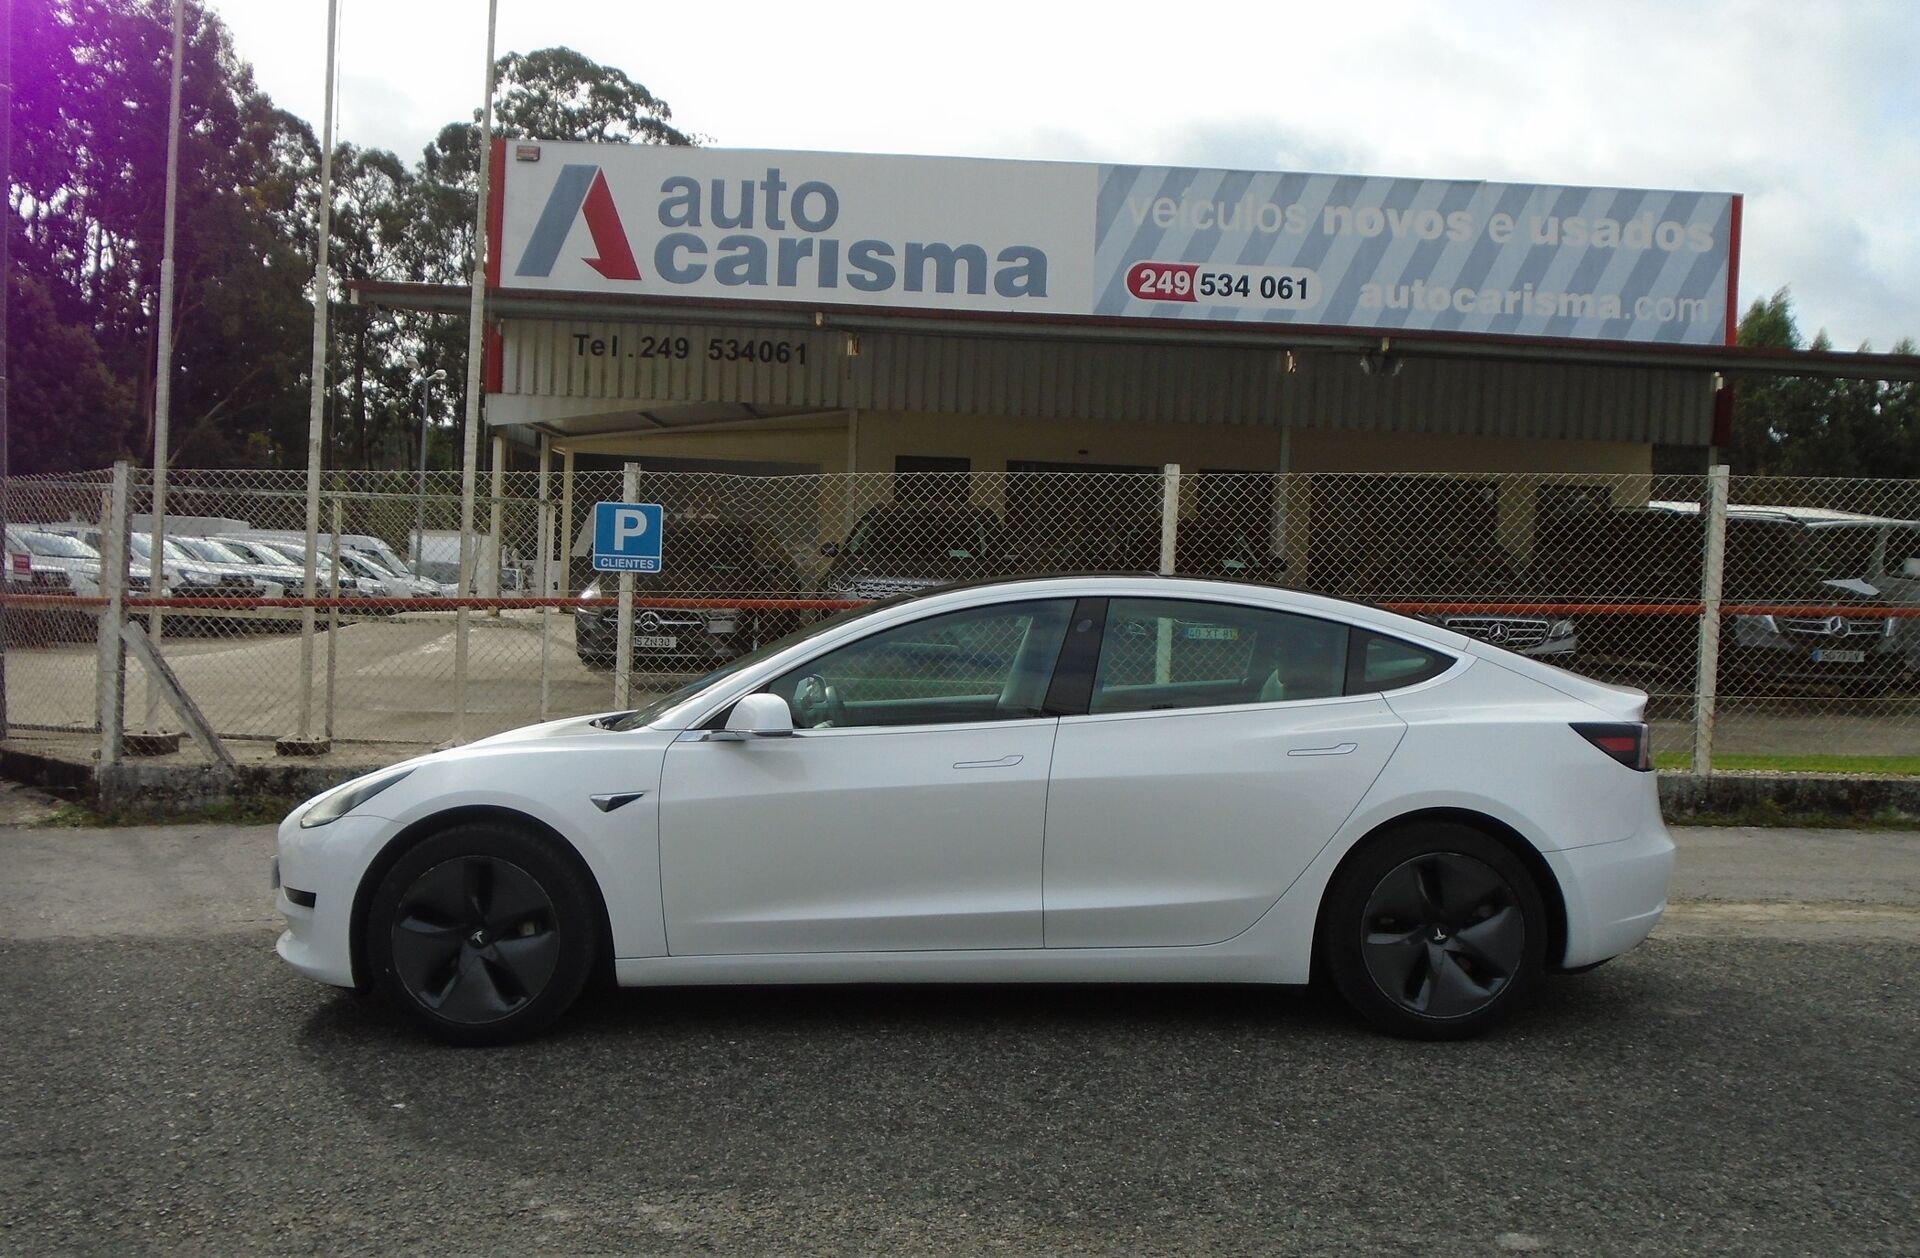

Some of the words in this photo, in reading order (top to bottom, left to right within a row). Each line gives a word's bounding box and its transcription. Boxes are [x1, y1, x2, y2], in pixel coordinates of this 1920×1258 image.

[657, 167, 839, 232] auto
[1128, 187, 1307, 235] veículos
[1322, 203, 1473, 242] novos
[1488, 212, 1515, 238] e
[1529, 211, 1714, 253] usados
[1139, 268, 1191, 295] 249
[1200, 273, 1250, 298] 534
[1260, 275, 1307, 300] 061
[1359, 278, 1709, 323] autocarisma.com
[708, 338, 806, 365] 534061
[614, 508, 648, 551] P
[600, 557, 654, 569] CLIENTES
